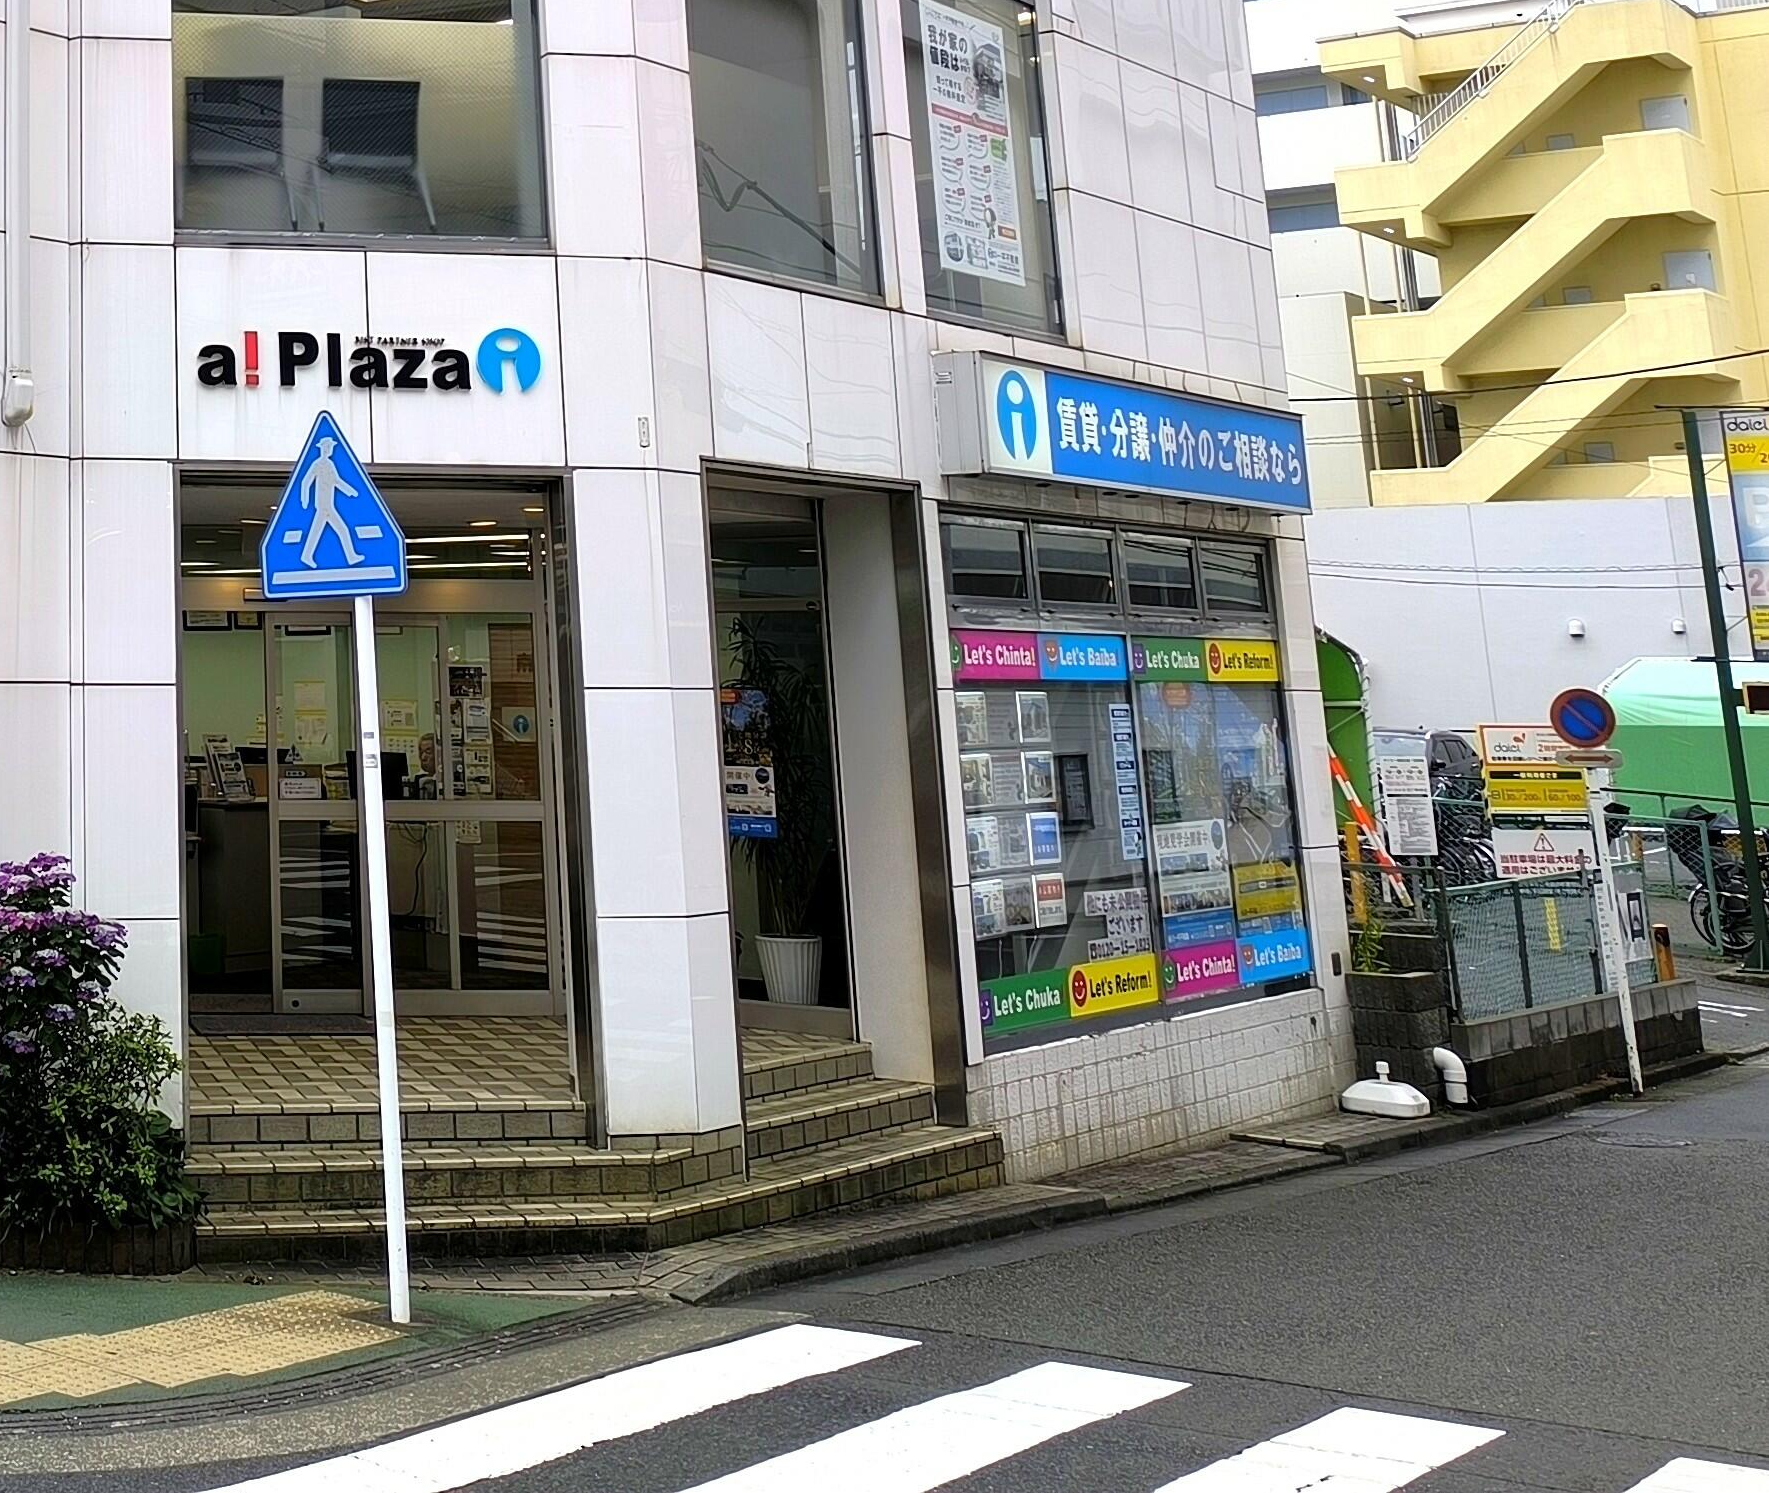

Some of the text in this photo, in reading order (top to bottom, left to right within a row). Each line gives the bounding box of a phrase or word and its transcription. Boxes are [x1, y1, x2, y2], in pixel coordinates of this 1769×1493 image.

[928, 24, 968, 54] 我が家の
[930, 46, 960, 71] 値段は
[278, 331, 471, 390] Plaza
[1056, 395, 1302, 486] 賃貸・分譲・仲介のご相談なら
[1729, 443, 1756, 454] 30分
[1748, 569, 1769, 598] 2
[964, 644, 1036, 668] Let's Chinta!
[1060, 646, 1117, 667] Let's Baiba
[1146, 649, 1200, 670] Let's Chuka
[1223, 651, 1273, 671] Let's Reform!
[1176, 954, 1236, 983] Let's Chinta!
[1254, 944, 1302, 968] Let's Baiba
[1089, 970, 1152, 999] Let's Reform!
[993, 987, 1061, 1018] Let's Chuka
